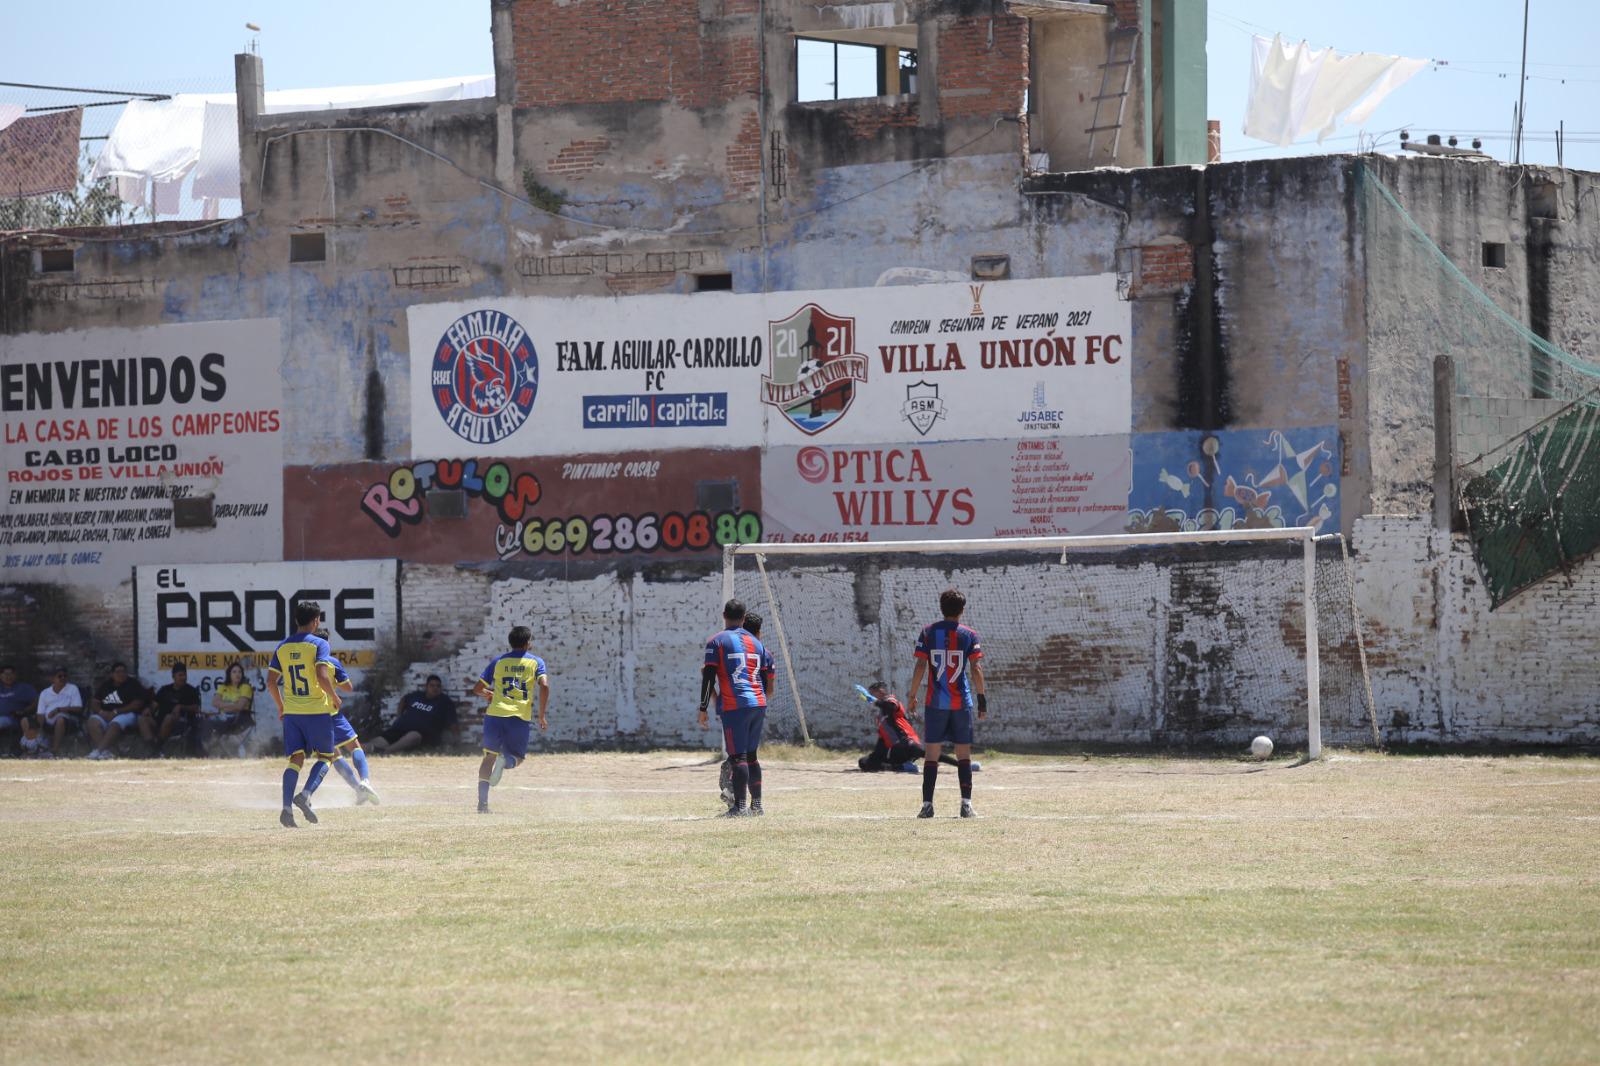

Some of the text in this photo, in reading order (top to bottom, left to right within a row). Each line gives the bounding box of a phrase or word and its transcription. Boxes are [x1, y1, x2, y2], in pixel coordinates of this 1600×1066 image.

[447, 311, 525, 353] FAMILIA
[890, 310, 1092, 334] CAMPEON SEGUNDA DE VERANO 2021
[555, 335, 762, 372] FAM. AGUILAR-CARRILLO
[776, 326, 847, 358] 20 21
[879, 328, 1123, 374] VILLA UNIÓN FC
[645, 370, 666, 391] FC
[767, 359, 863, 403] VILLA UNION FC
[446, 401, 527, 443] AGUILAR
[587, 397, 648, 422] carrillo
[1017, 410, 1064, 423] JUSABEC
[6, 410, 280, 443] LA CASA DE LOS CAMPEONES
[25, 444, 177, 467] CABO LOCO
[562, 461, 660, 479] PINTAMOS CASAS
[8, 469, 73, 483] ROJOS
[79, 467, 102, 480] DE
[109, 464, 167, 479] VILLA
[10, 489, 23, 504] EN
[25, 488, 65, 504] MEMORIA
[69, 488, 81, 502] DE
[84, 487, 128, 502] NUESTROS
[361, 459, 542, 535] ROTULOS
[833, 488, 975, 525] WILLYS
[495, 521, 523, 560] Cel
[523, 519, 588, 554] 669
[592, 515, 659, 551] 286
[71, 551, 102, 565] GOMEZ
[157, 569, 185, 588] EL
[157, 588, 375, 652] PROFE
[160, 654, 200, 668] RENTA
[205, 654, 217, 668] DE
[728, 652, 760, 685] 27
[930, 649, 964, 684] 99
[289, 664, 309, 696] 15
[411, 701, 433, 712] POLO
